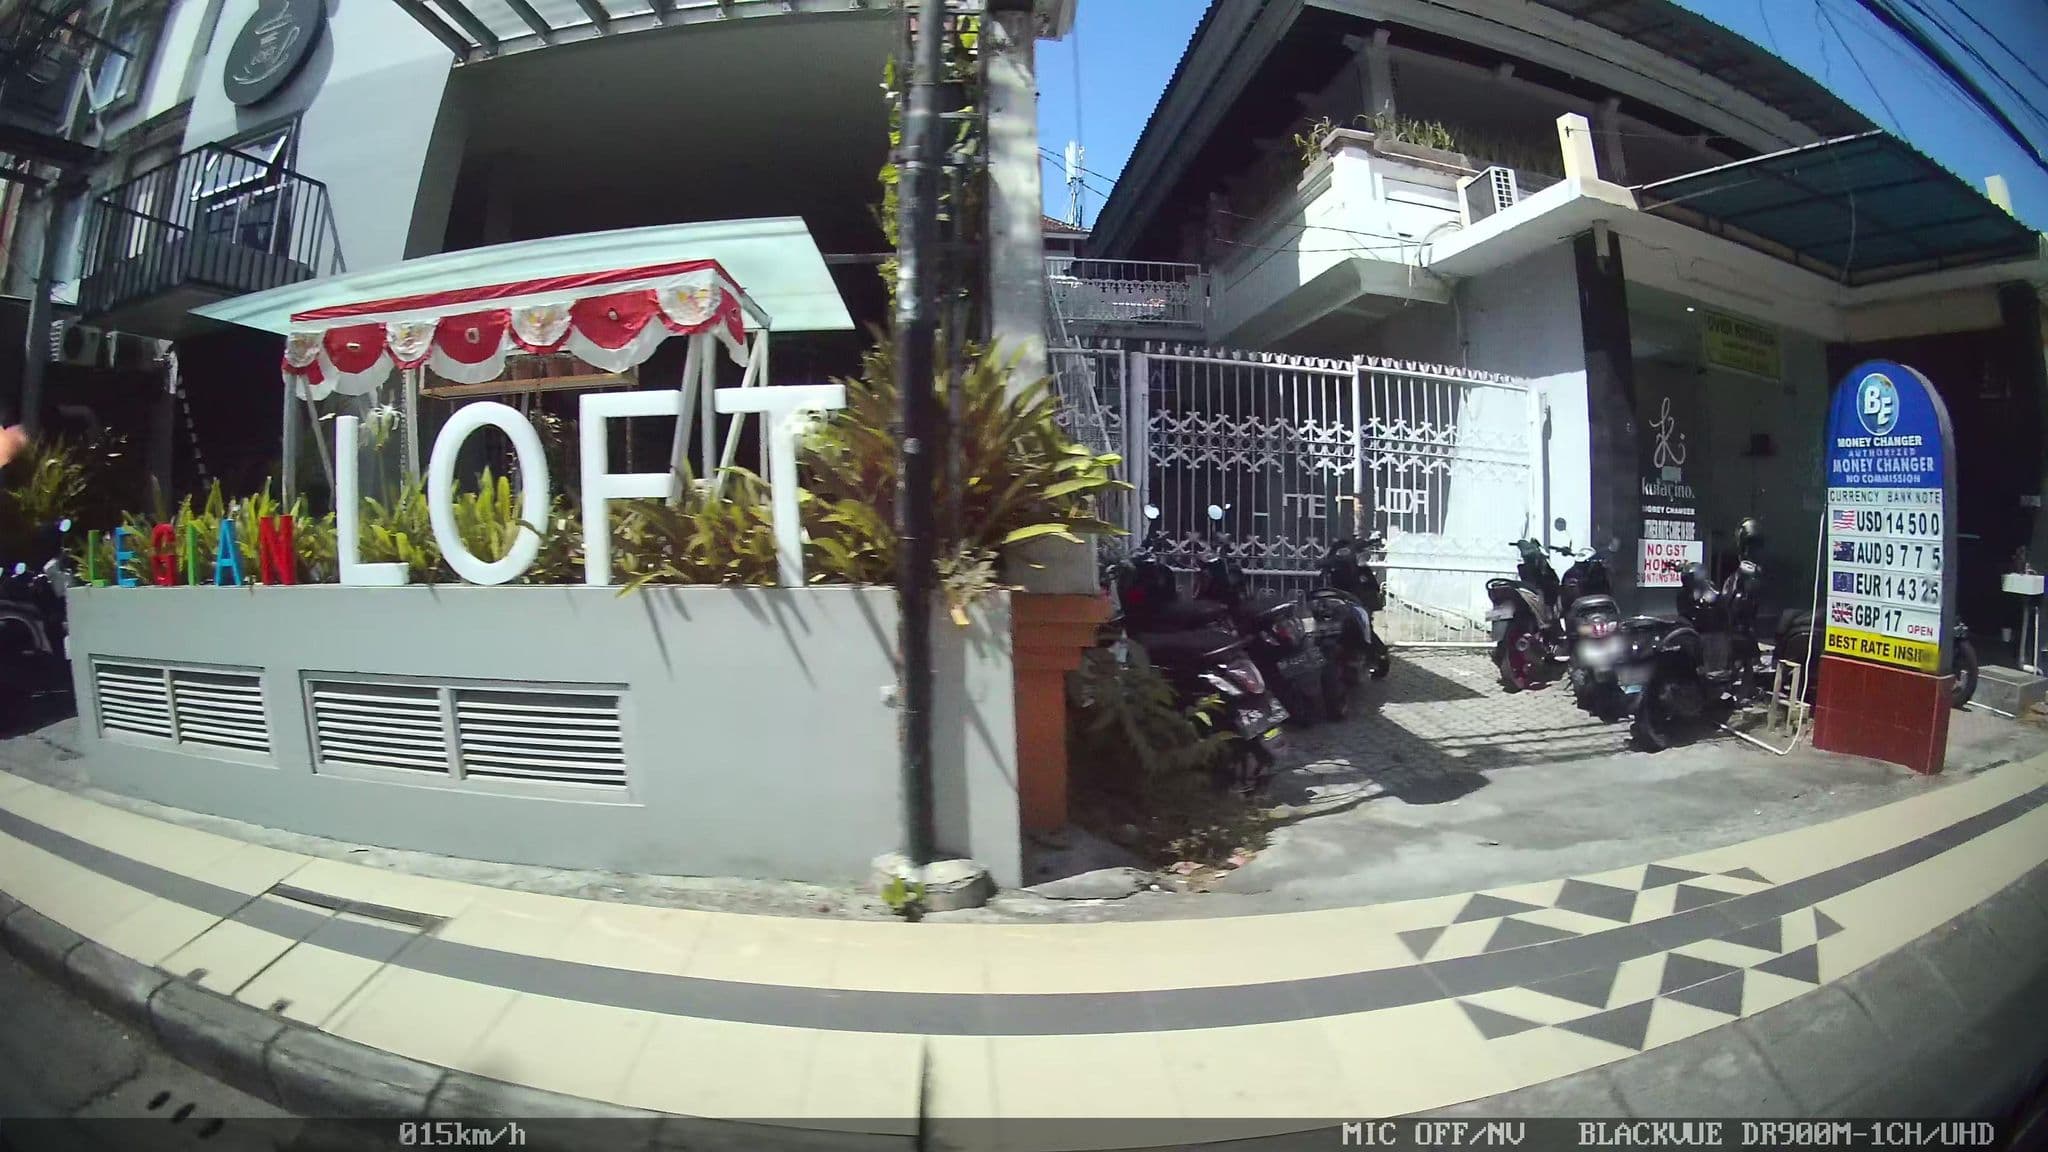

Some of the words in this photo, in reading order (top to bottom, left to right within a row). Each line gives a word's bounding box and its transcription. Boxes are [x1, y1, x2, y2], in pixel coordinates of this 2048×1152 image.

[1837, 437, 1872, 448] MONEY
[1873, 435, 1922, 447] CHANGER
[1848, 448, 1916, 457] AUTHORIZED
[1832, 458, 1873, 473] MONEY
[1876, 457, 1934, 472] CHANGER
[87, 514, 294, 588] LEGIAN
[335, 384, 846, 588] LOFT
[1846, 474, 1860, 483] NO
[1861, 474, 1921, 484] COMMISSION
[1829, 490, 1879, 502] CURRENCY
[1887, 491, 1913, 502] BANK
[1915, 491, 1942, 504] NOTE
[1856, 511, 1882, 532] USD
[1886, 511, 1940, 536] 14500
[1647, 544, 1663, 556] NO
[1666, 544, 1688, 557] GST
[1856, 542, 1882, 564] AUD
[1885, 543, 1941, 572] 9775
[1856, 571, 1881, 597] EUR
[1885, 576, 1939, 605] 14325
[1855, 604, 1880, 628] GBP
[1884, 609, 1902, 632] 17
[1907, 624, 1933, 637] OPEN
[1828, 633, 1857, 650] BEST
[1860, 639, 1890, 657] RATE
[1894, 644, 1932, 664] INSI
